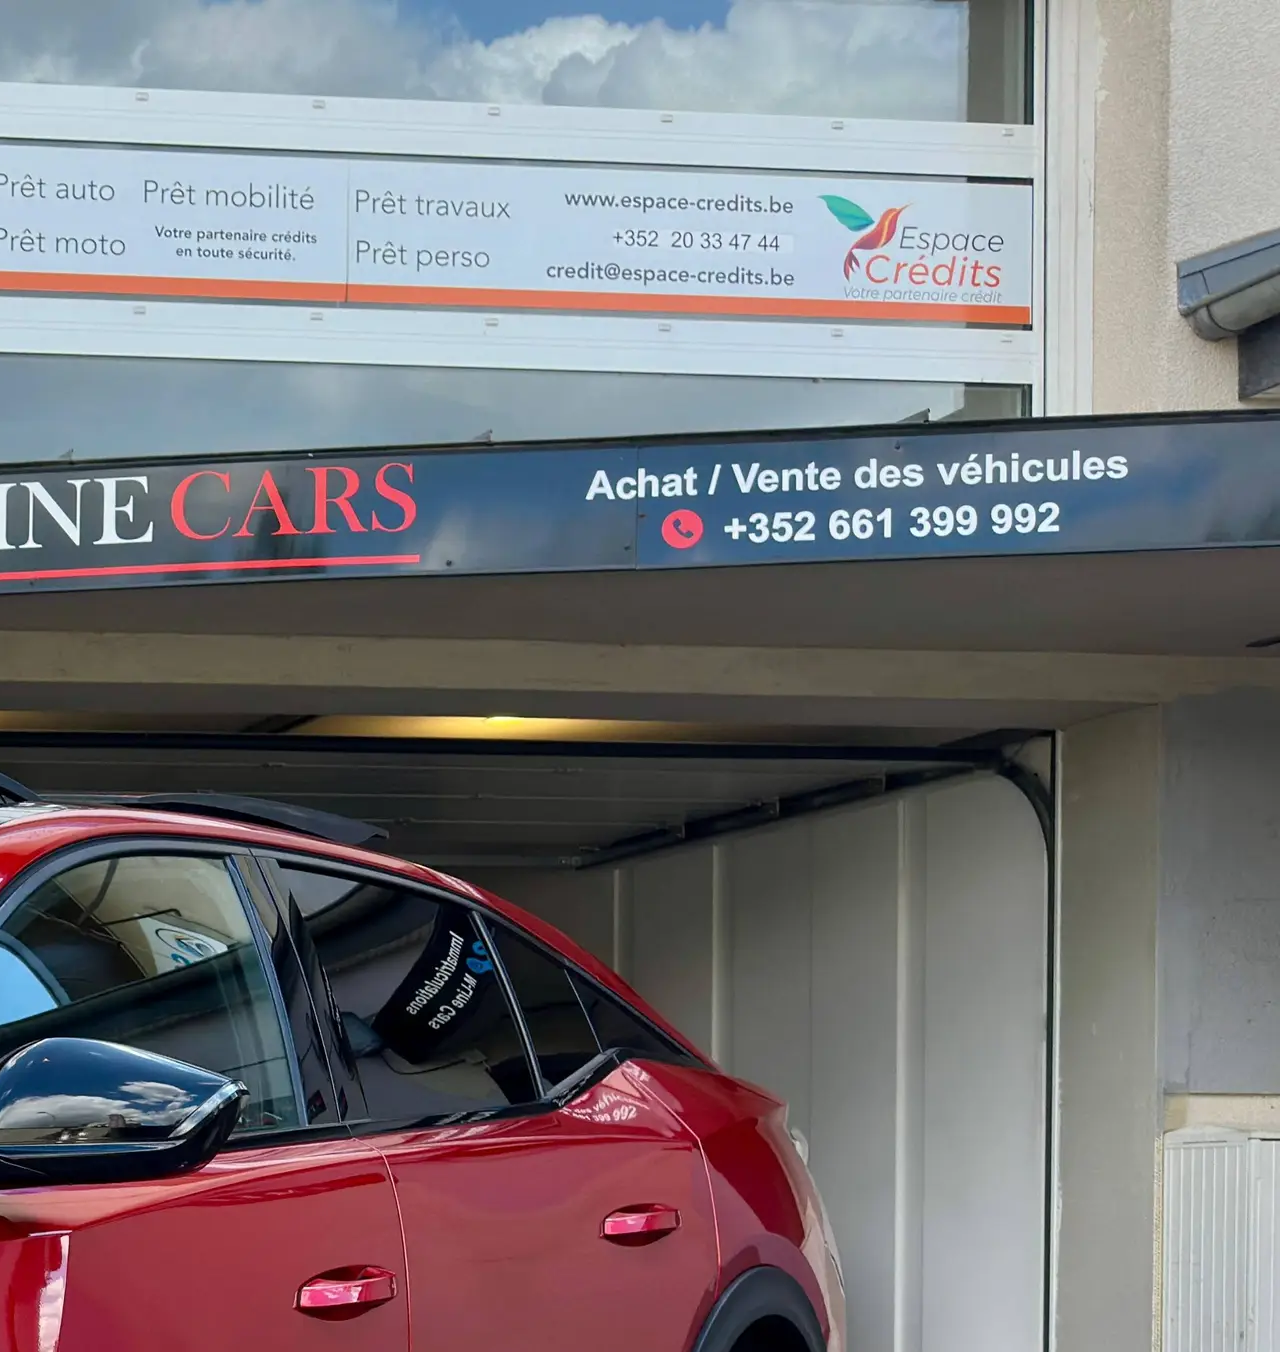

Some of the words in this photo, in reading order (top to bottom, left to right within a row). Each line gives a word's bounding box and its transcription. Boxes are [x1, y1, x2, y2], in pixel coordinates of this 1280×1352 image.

[55, 175, 116, 202] auto
[143, 179, 197, 206] Prêt
[206, 182, 315, 211] mobilité
[564, 190, 794, 217] www.espace-credits.be
[356, 189, 407, 216] Prêt
[415, 192, 511, 219] travaux
[55, 231, 127, 257] moto
[155, 225, 193, 240] Votre
[197, 228, 268, 245] partenaire
[272, 230, 318, 245] crédits
[612, 231, 659, 248] +352
[671, 233, 695, 249] 20
[700, 234, 724, 250] 33
[729, 235, 752, 251] 47
[756, 236, 780, 252] 44
[899, 226, 1005, 256] Espace
[176, 249, 192, 258] en
[197, 247, 234, 260] toute
[238, 246, 297, 263] sécurité.
[356, 240, 407, 267] Prêt
[416, 248, 491, 273] perso
[546, 261, 795, 292] credit@espace-credits.be
[865, 254, 1001, 289] Crédits
[843, 286, 880, 301] Votre
[883, 287, 957, 306] partenaire
[961, 289, 1002, 304] crédit
[585, 464, 698, 501] Achat
[708, 463, 721, 496] /
[731, 459, 841, 496] Vente
[854, 455, 924, 489] des
[937, 449, 1130, 486] véhicules
[170, 462, 417, 540] CARS
[724, 508, 816, 543] +352
[828, 506, 894, 539] 661
[909, 504, 978, 537] 399
[991, 501, 1061, 534] 992
